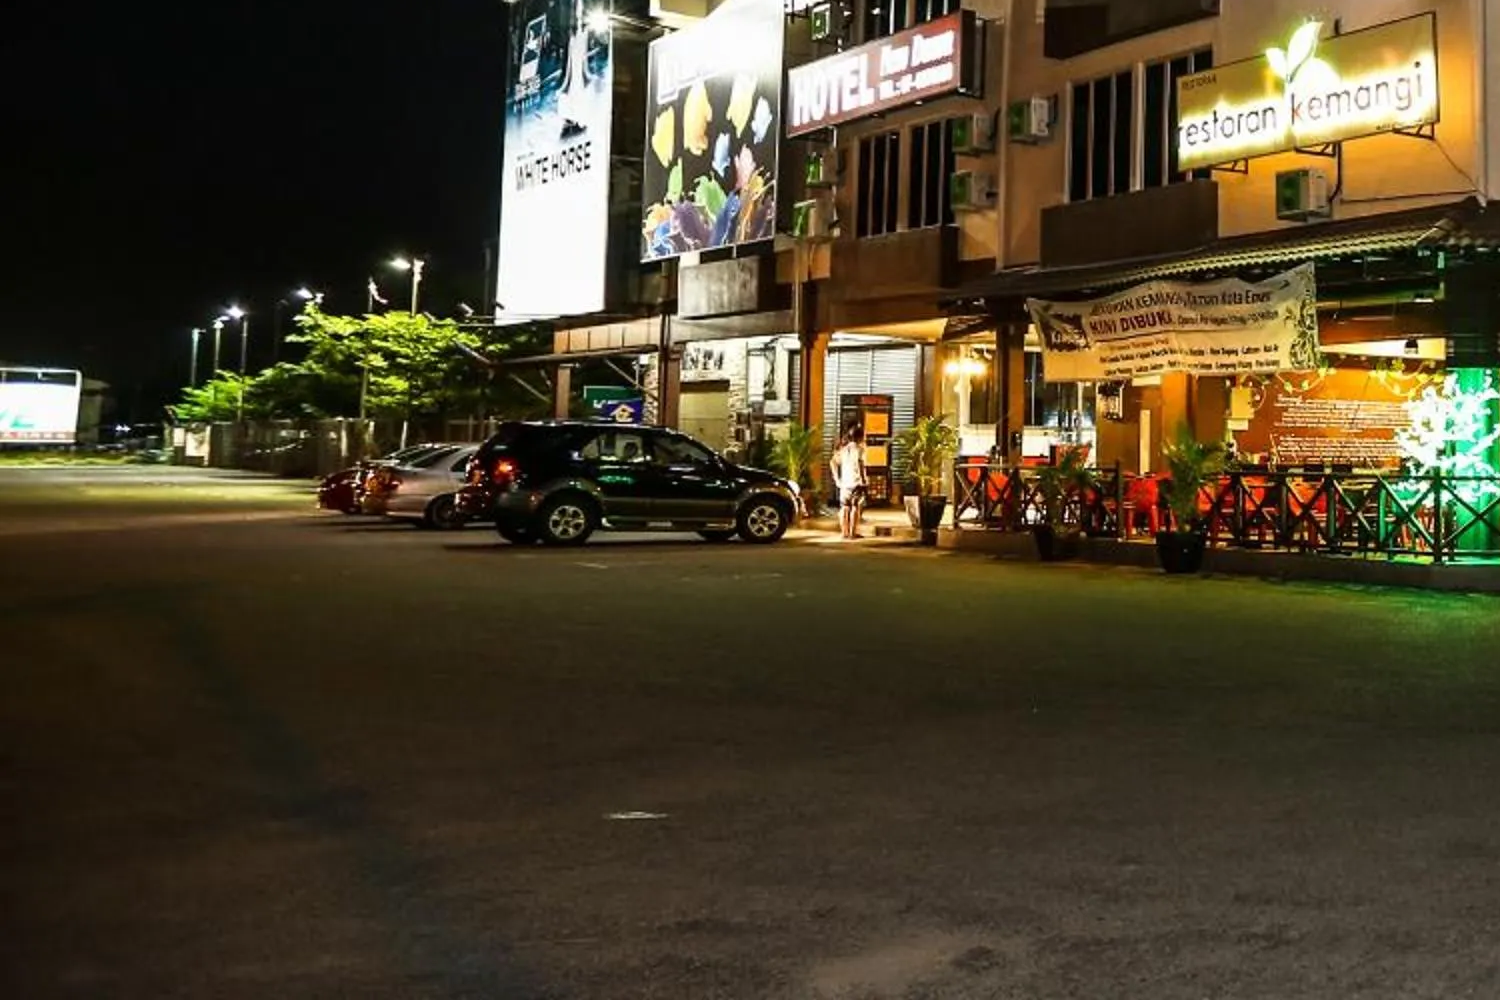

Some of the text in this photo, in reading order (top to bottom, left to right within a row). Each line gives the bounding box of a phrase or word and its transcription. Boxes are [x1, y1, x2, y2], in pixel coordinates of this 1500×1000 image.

[791, 52, 875, 127] HOTEL
[1176, 60, 1424, 148] restoran kemangi
[515, 141, 592, 191] WHITE HORSE
